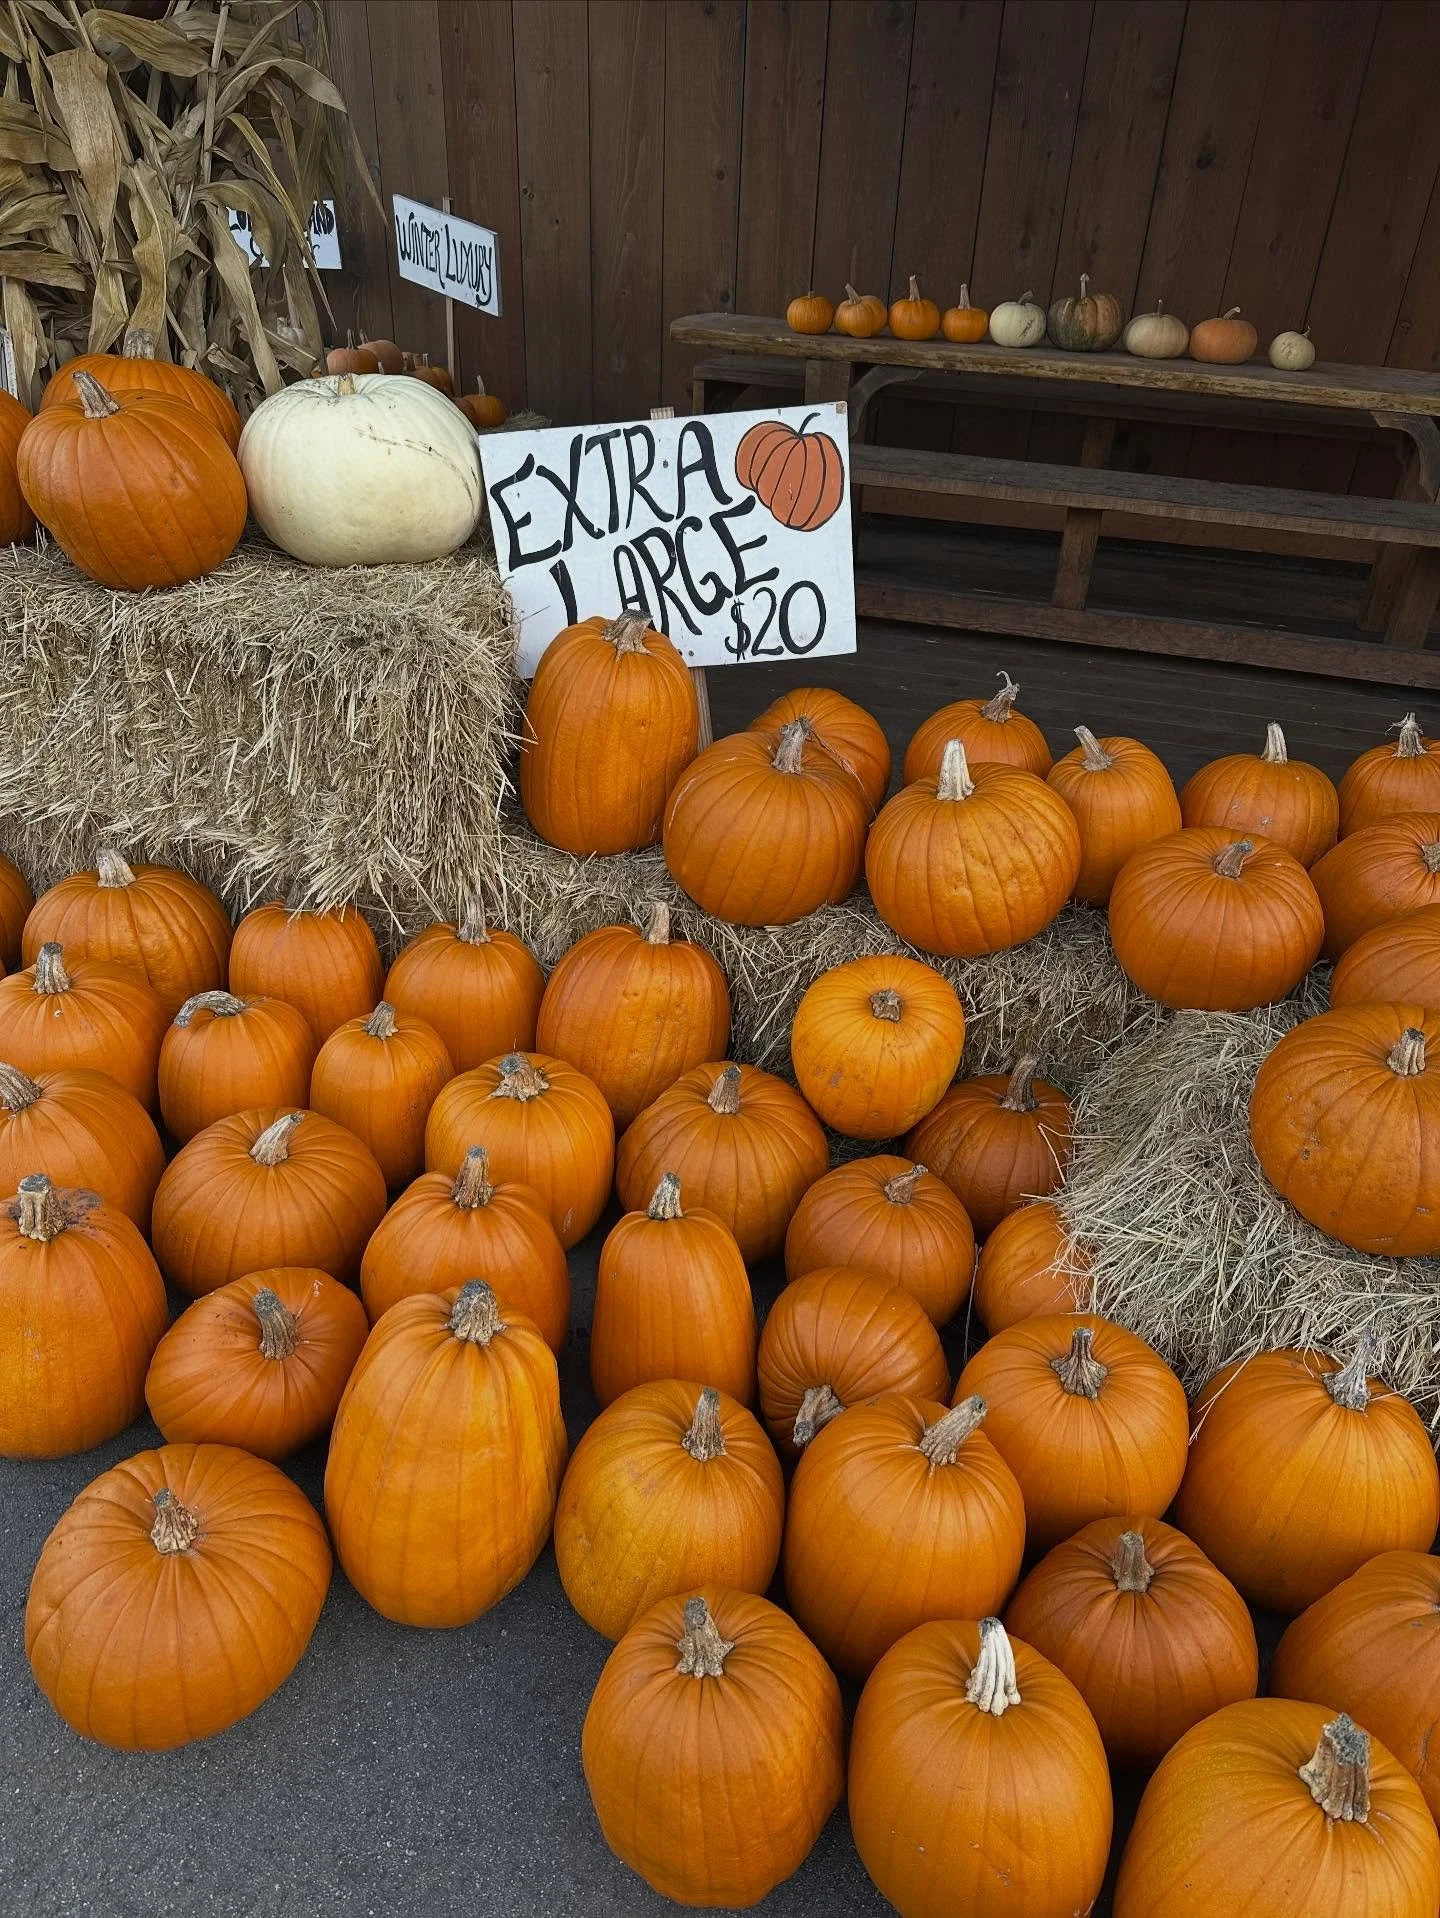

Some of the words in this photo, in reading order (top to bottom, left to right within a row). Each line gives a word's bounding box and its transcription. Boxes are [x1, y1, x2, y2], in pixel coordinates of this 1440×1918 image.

[395, 211, 445, 289] WINTER
[445, 223, 492, 306] LUXURY
[490, 420, 733, 571] EXTRA
[725, 580, 826, 661] $20
